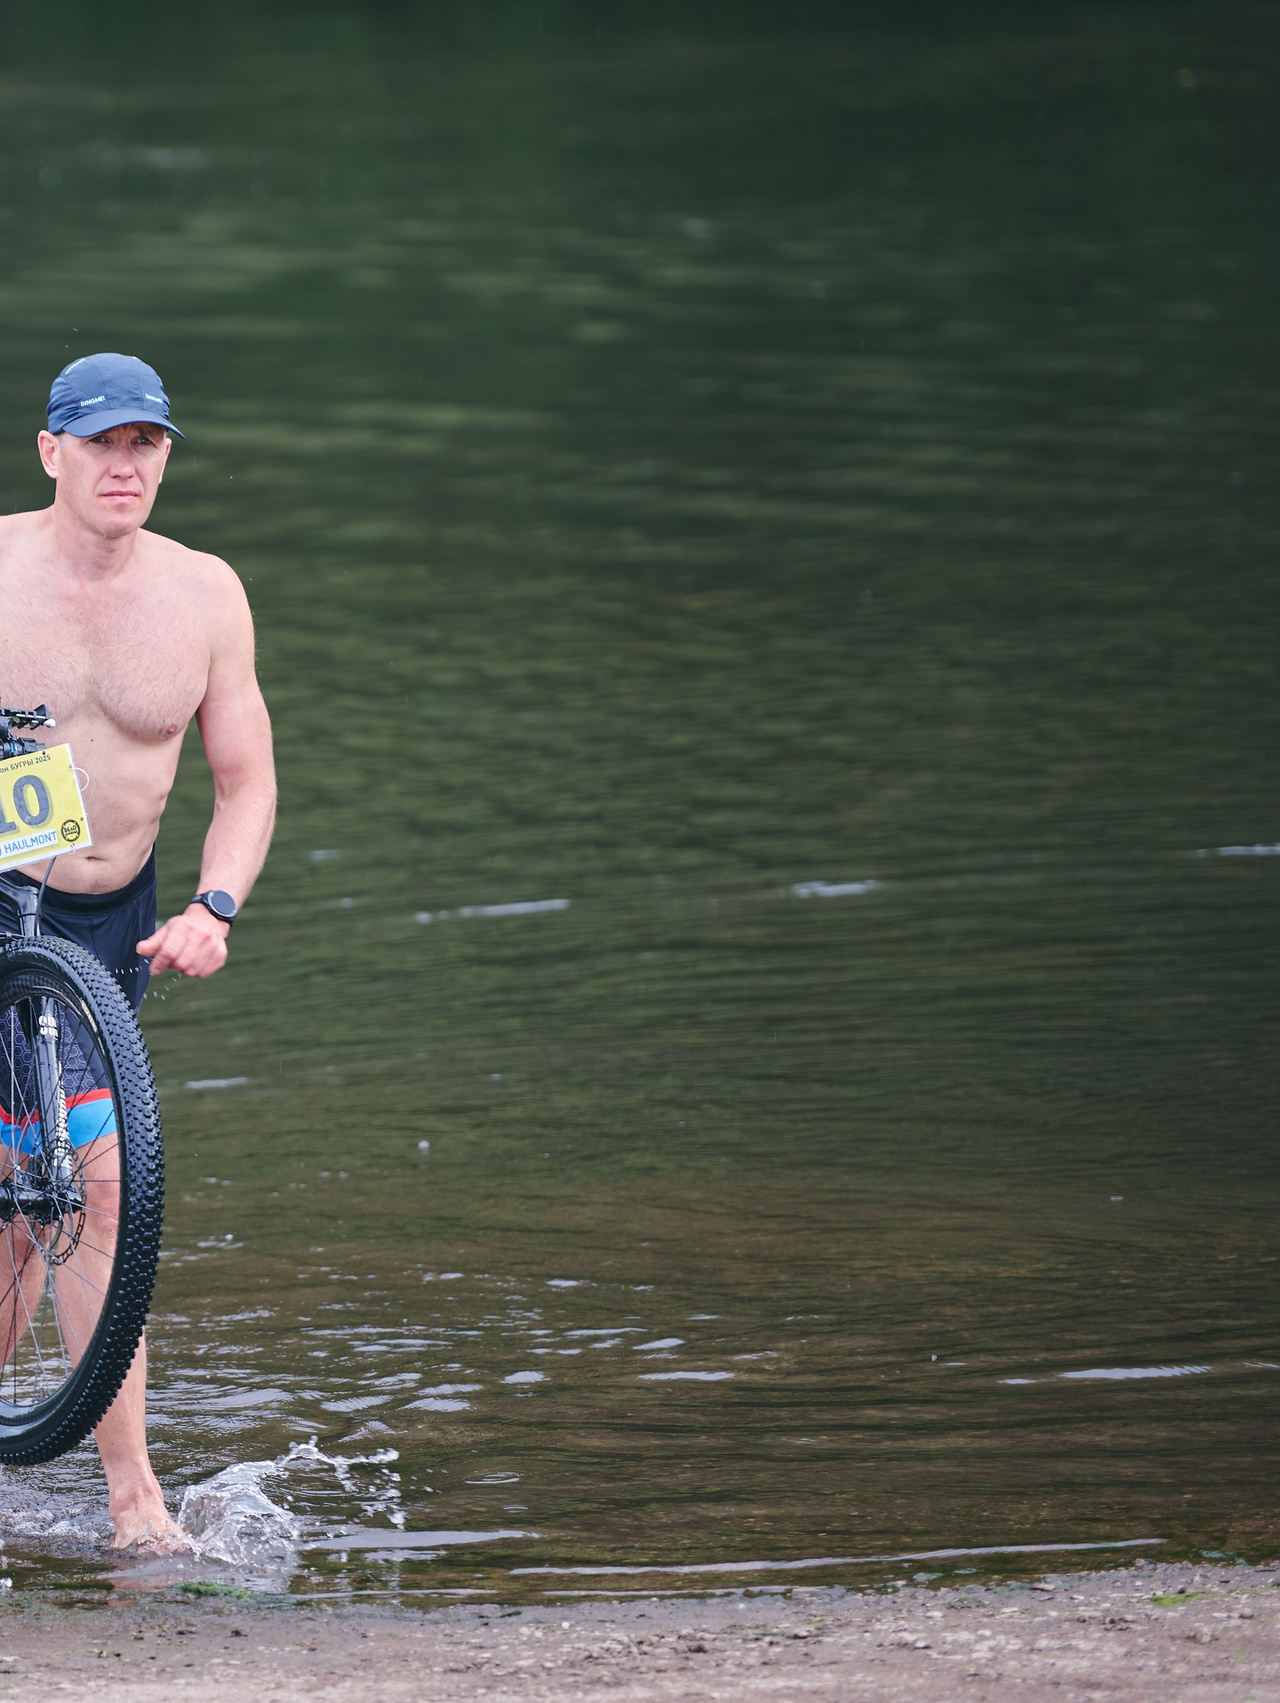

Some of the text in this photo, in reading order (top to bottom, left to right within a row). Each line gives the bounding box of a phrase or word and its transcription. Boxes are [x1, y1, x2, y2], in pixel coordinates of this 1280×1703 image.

[10, 758, 34, 771] БУГРЫ
[35, 755, 51, 765] 2025
[3, 831, 57, 854] HAULMONT
